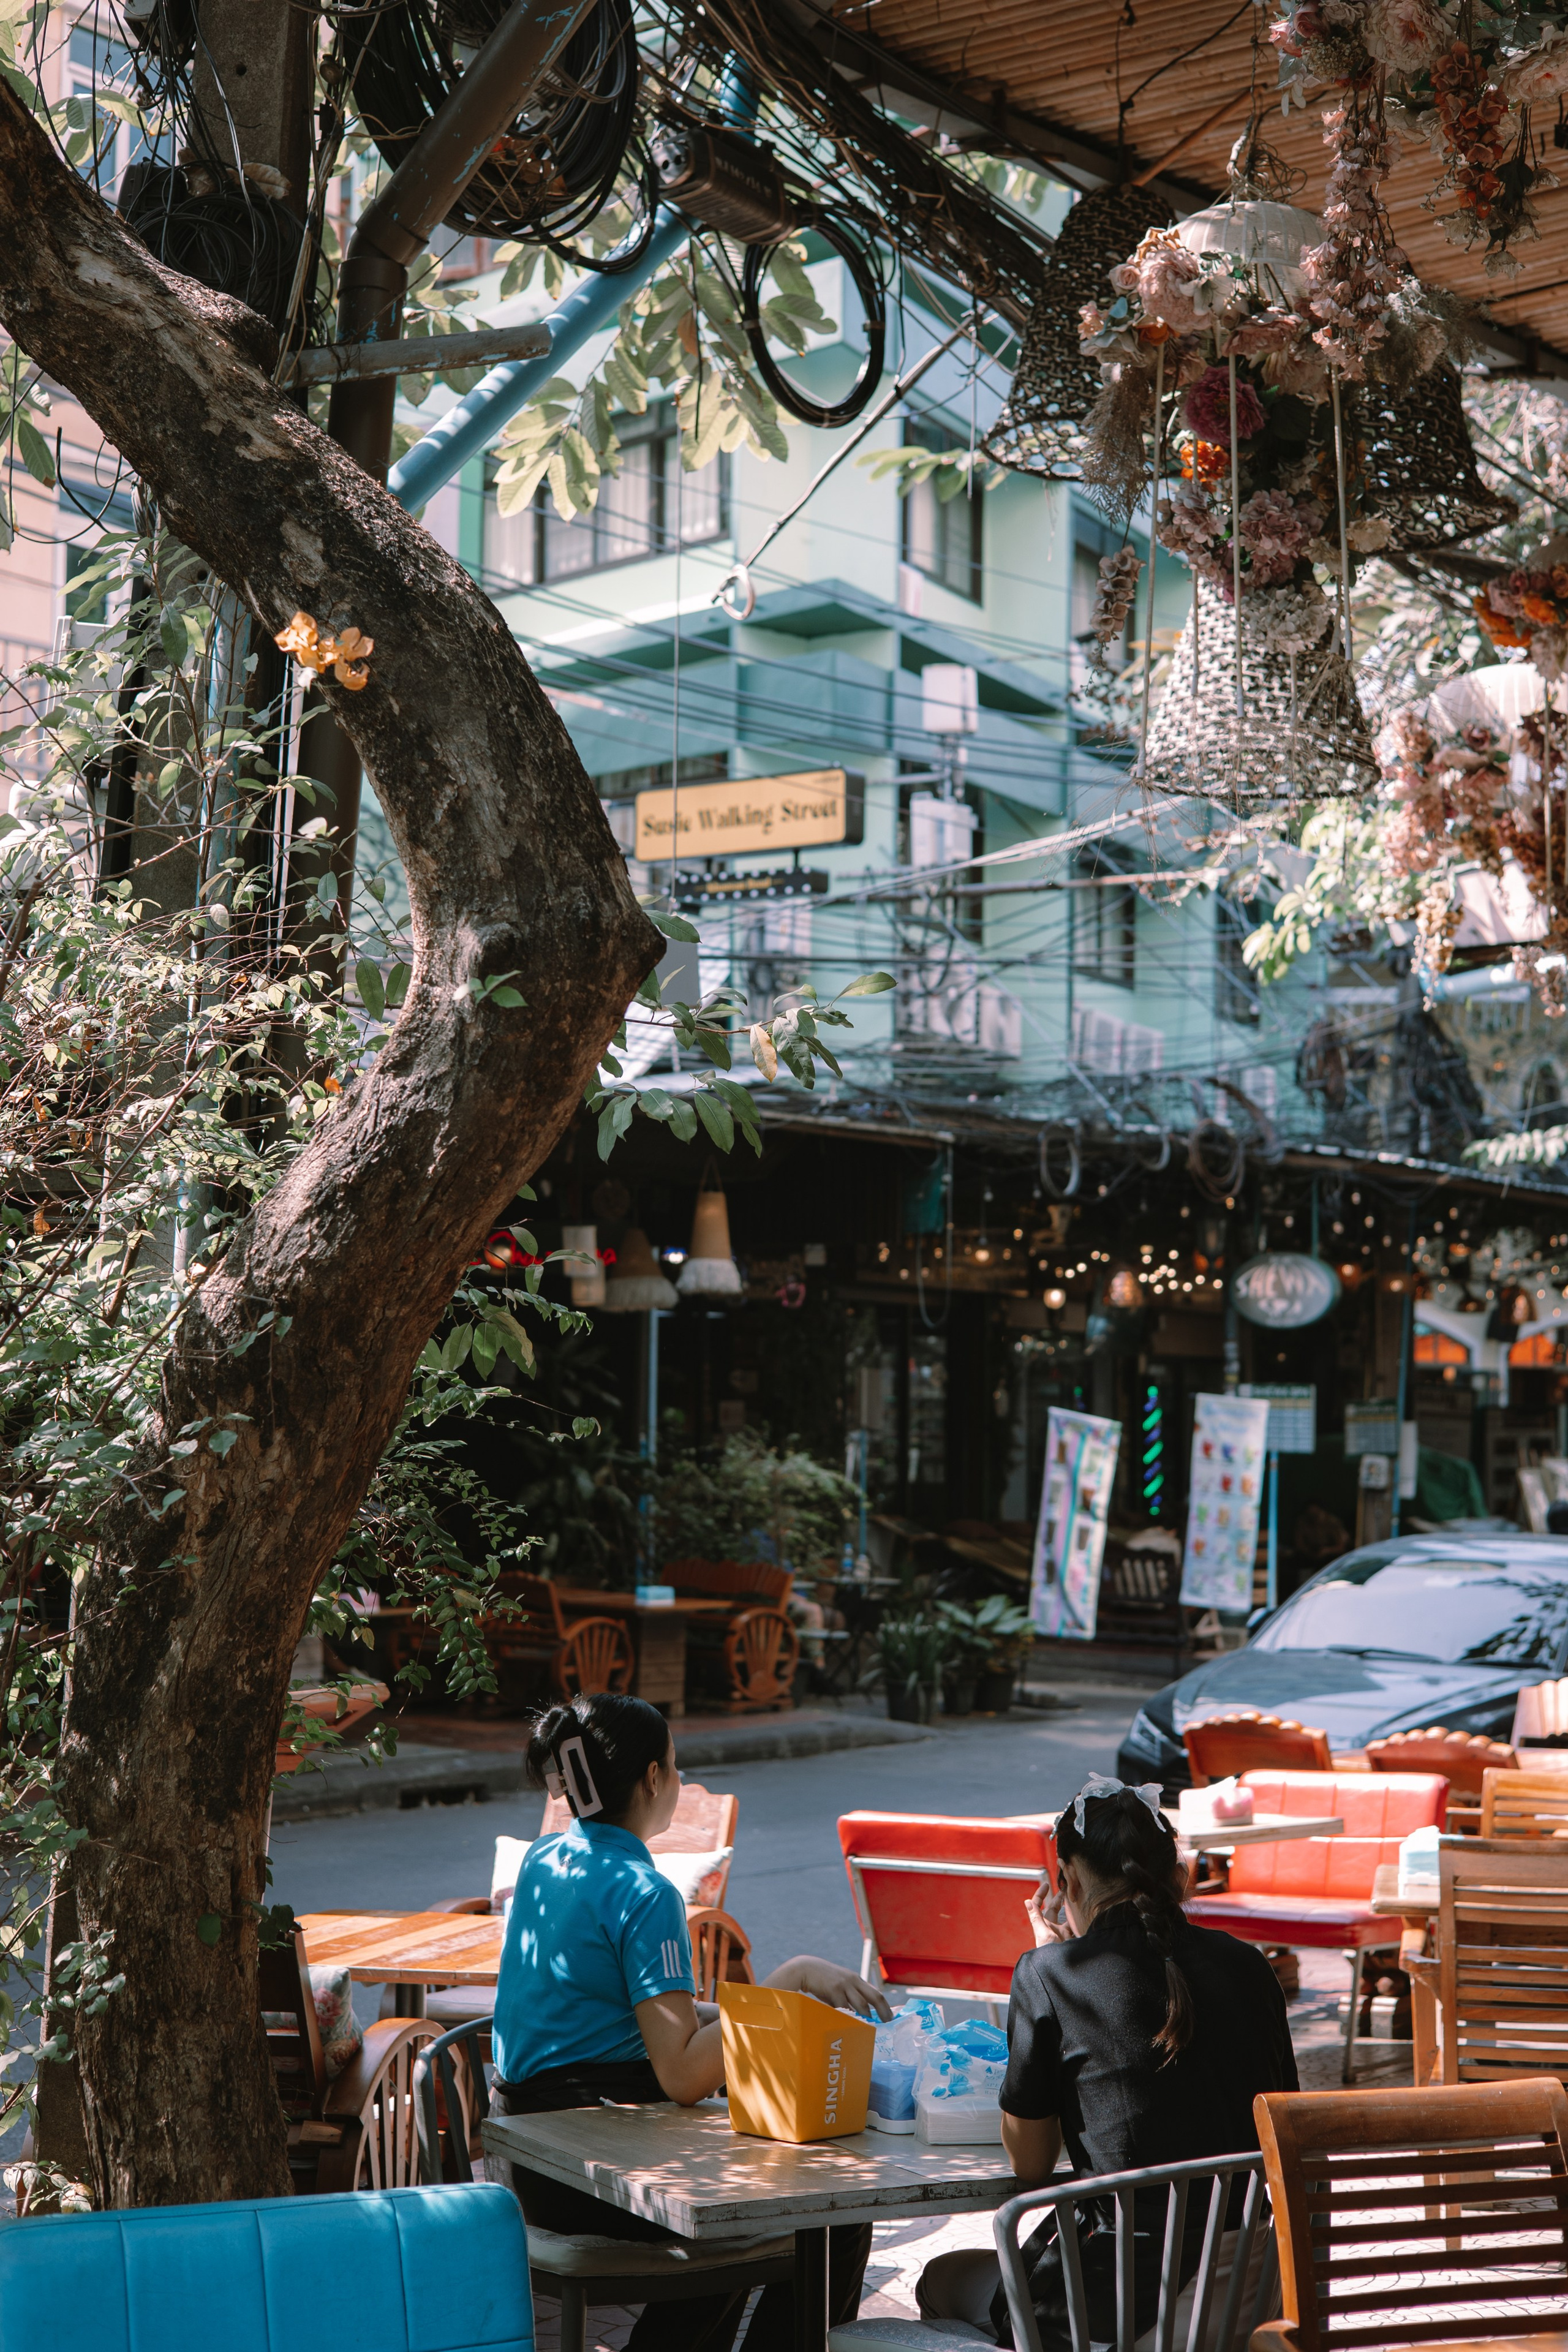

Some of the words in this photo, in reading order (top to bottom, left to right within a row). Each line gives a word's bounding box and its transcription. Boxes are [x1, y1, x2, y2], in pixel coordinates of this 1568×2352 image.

[643, 811, 692, 837] Susie
[698, 802, 774, 834] Walking
[781, 797, 837, 822] Street
[824, 2037, 843, 2125] SINGHA
